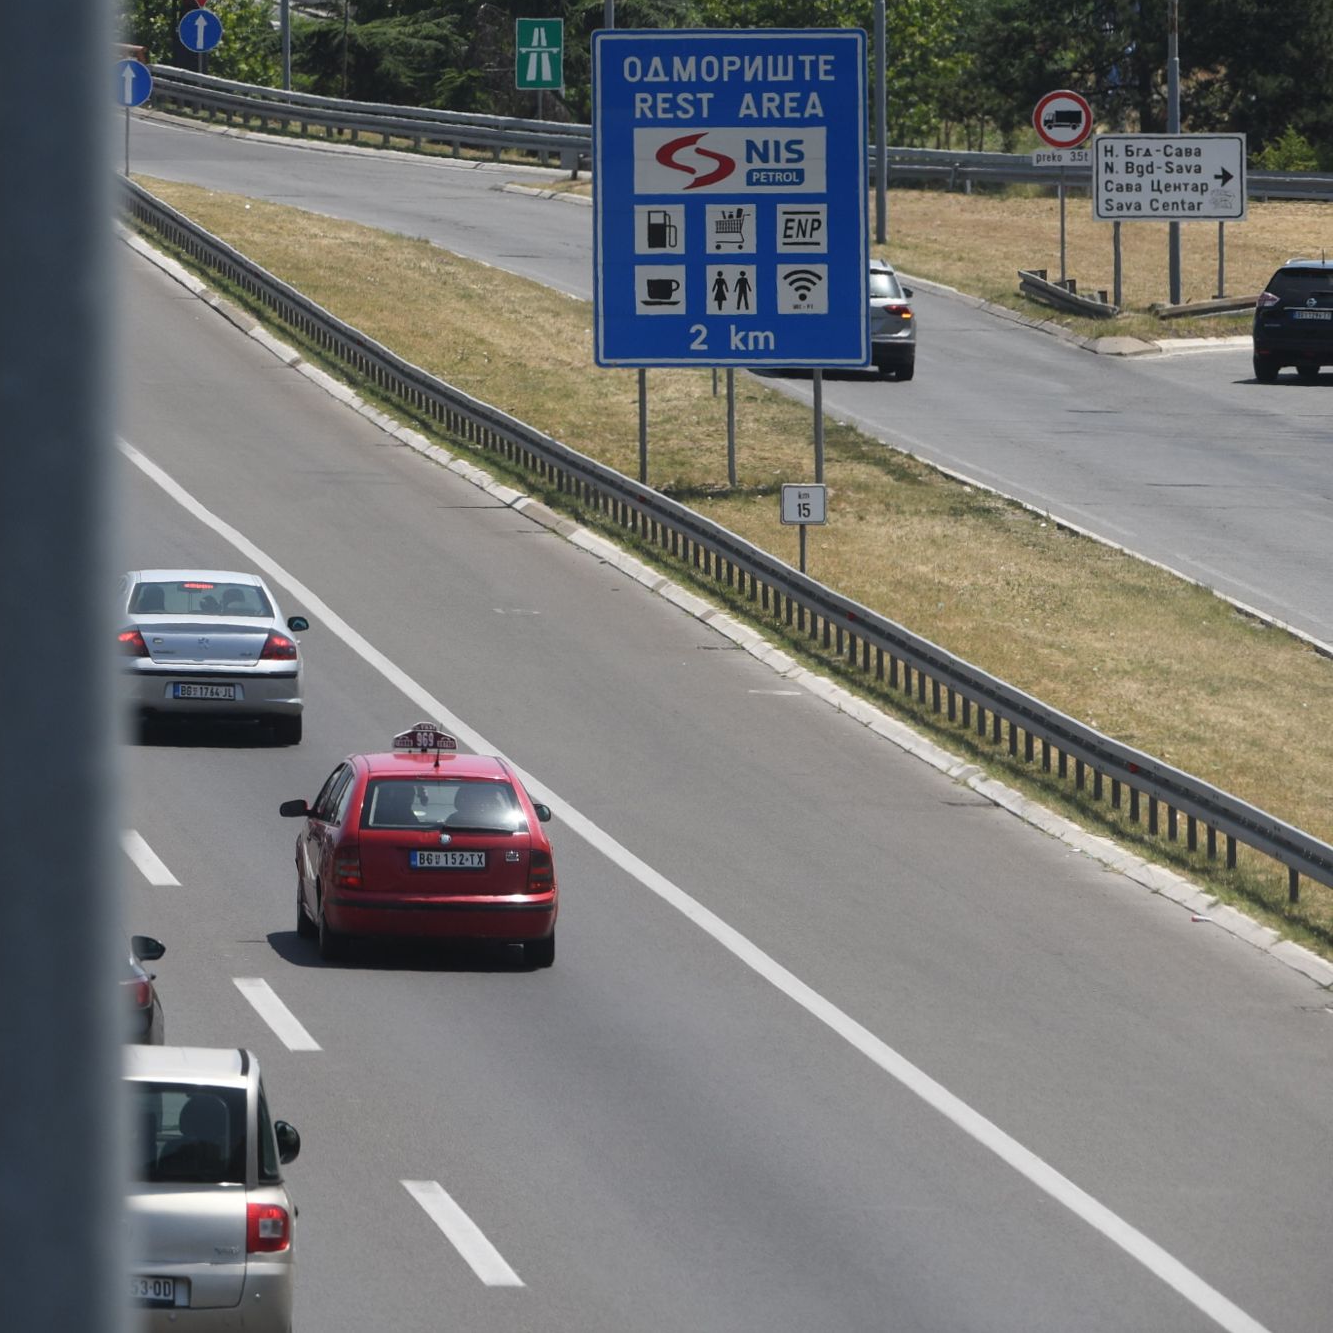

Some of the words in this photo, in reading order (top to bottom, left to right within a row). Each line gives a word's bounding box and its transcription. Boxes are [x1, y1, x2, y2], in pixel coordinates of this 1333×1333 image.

[623, 55, 836, 82] ОДМОРИШТЕ
[635, 92, 714, 118] REST
[738, 91, 825, 118] AREA
[745, 139, 805, 164] NIS
[1036, 152, 1063, 164] preko
[1104, 145, 1119, 157] Н.
[1125, 144, 1202, 158] Бгд-Сава
[1104, 162, 1119, 174] N.
[1125, 161, 1202, 177] Bgd-Sava
[752, 171, 800, 183] PETROL
[1104, 180, 1142, 193] Сава
[1151, 179, 1209, 195] Центар
[1105, 199, 1142, 212] Sava
[1150, 199, 1203, 212] Centar
[783, 218, 822, 239] ENP
[690, 324, 708, 350] 2
[730, 324, 775, 350] km
[797, 503, 811, 518] 15
[181, 684, 192, 696] BG
[416, 732, 434, 747] 969
[419, 851, 433, 865] BG
